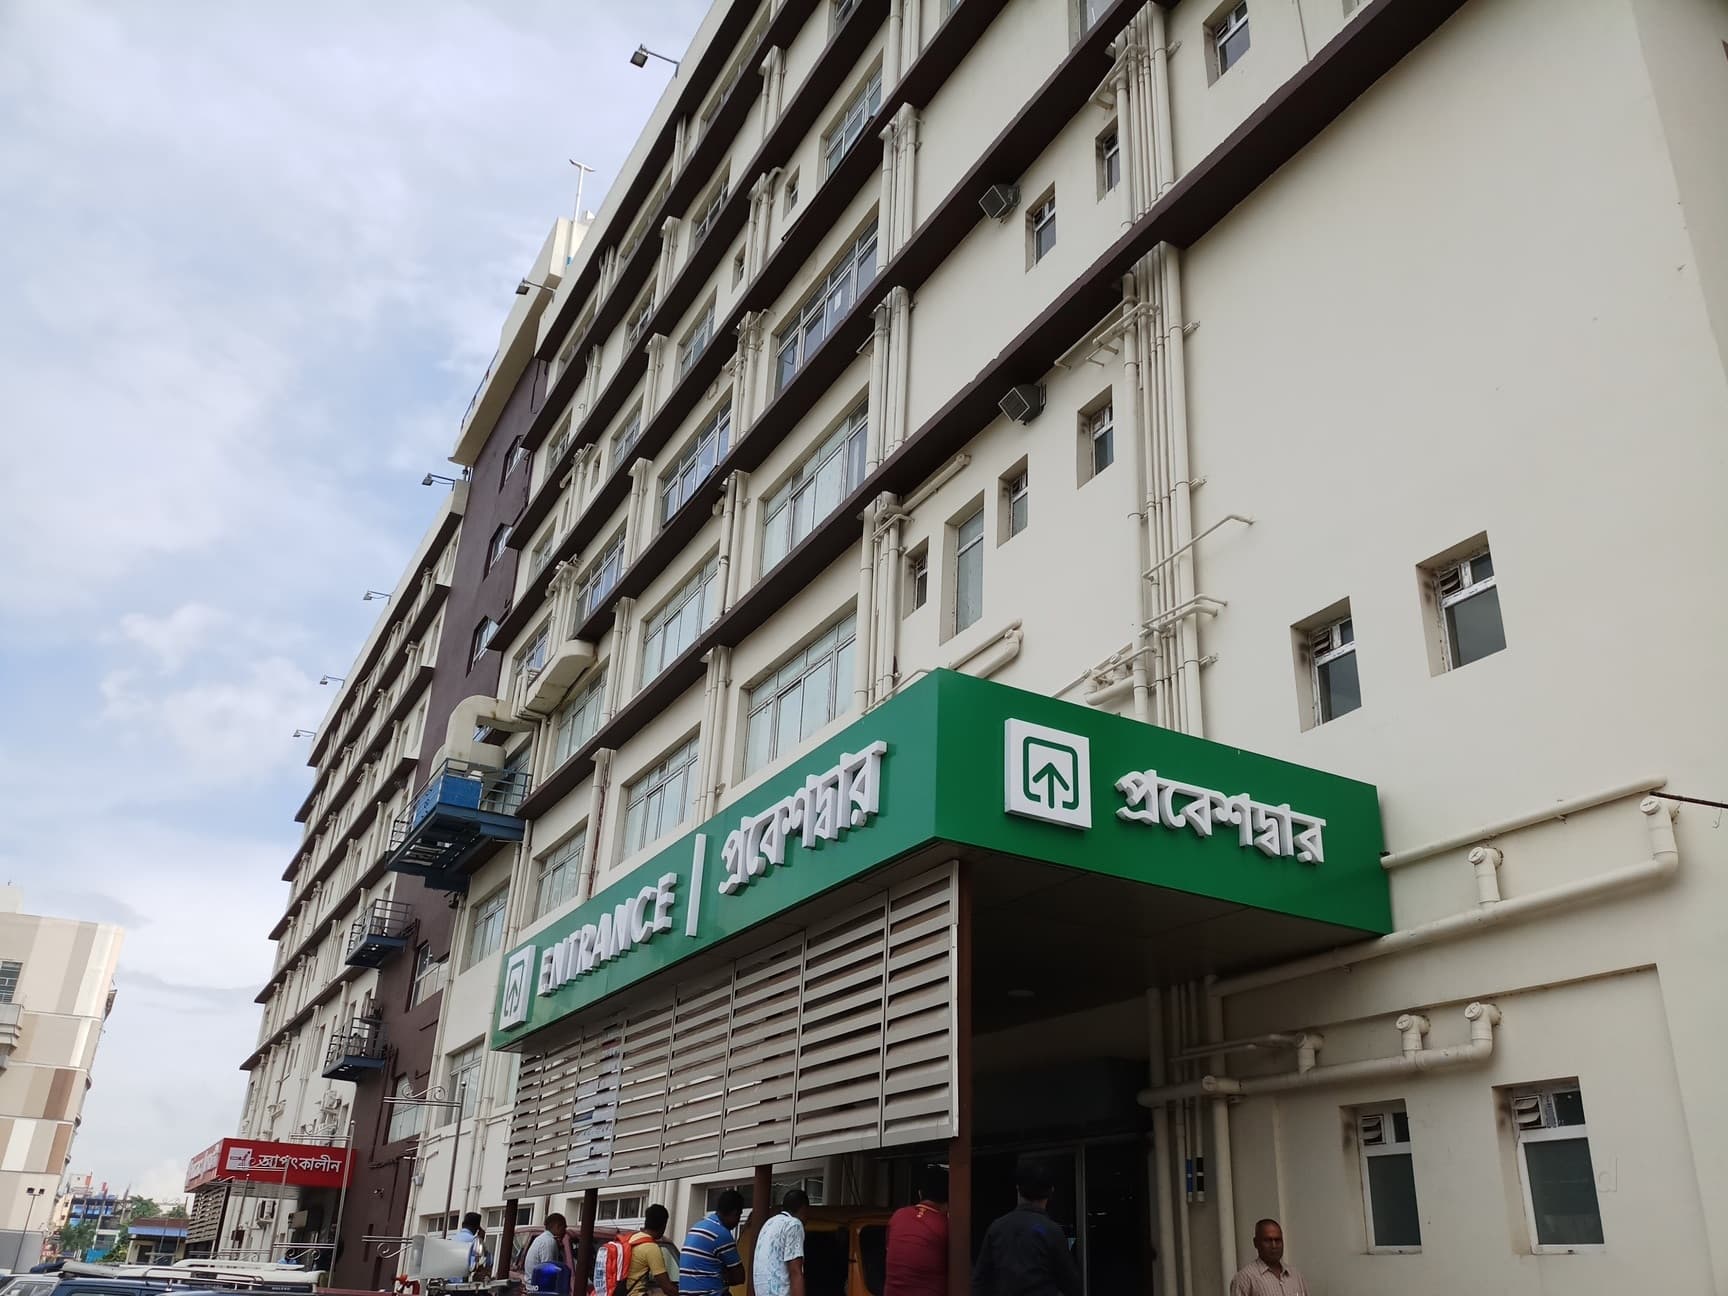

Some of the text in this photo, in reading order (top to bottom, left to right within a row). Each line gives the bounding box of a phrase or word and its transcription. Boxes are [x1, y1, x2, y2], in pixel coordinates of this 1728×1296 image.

[718, 740, 887, 894] প্রবেশদ্বার
[1114, 769, 1326, 863] প্রবেশদ্বার
[537, 872, 677, 996] ENTRANCE
[258, 1154, 342, 1173] আপৎকালীন
